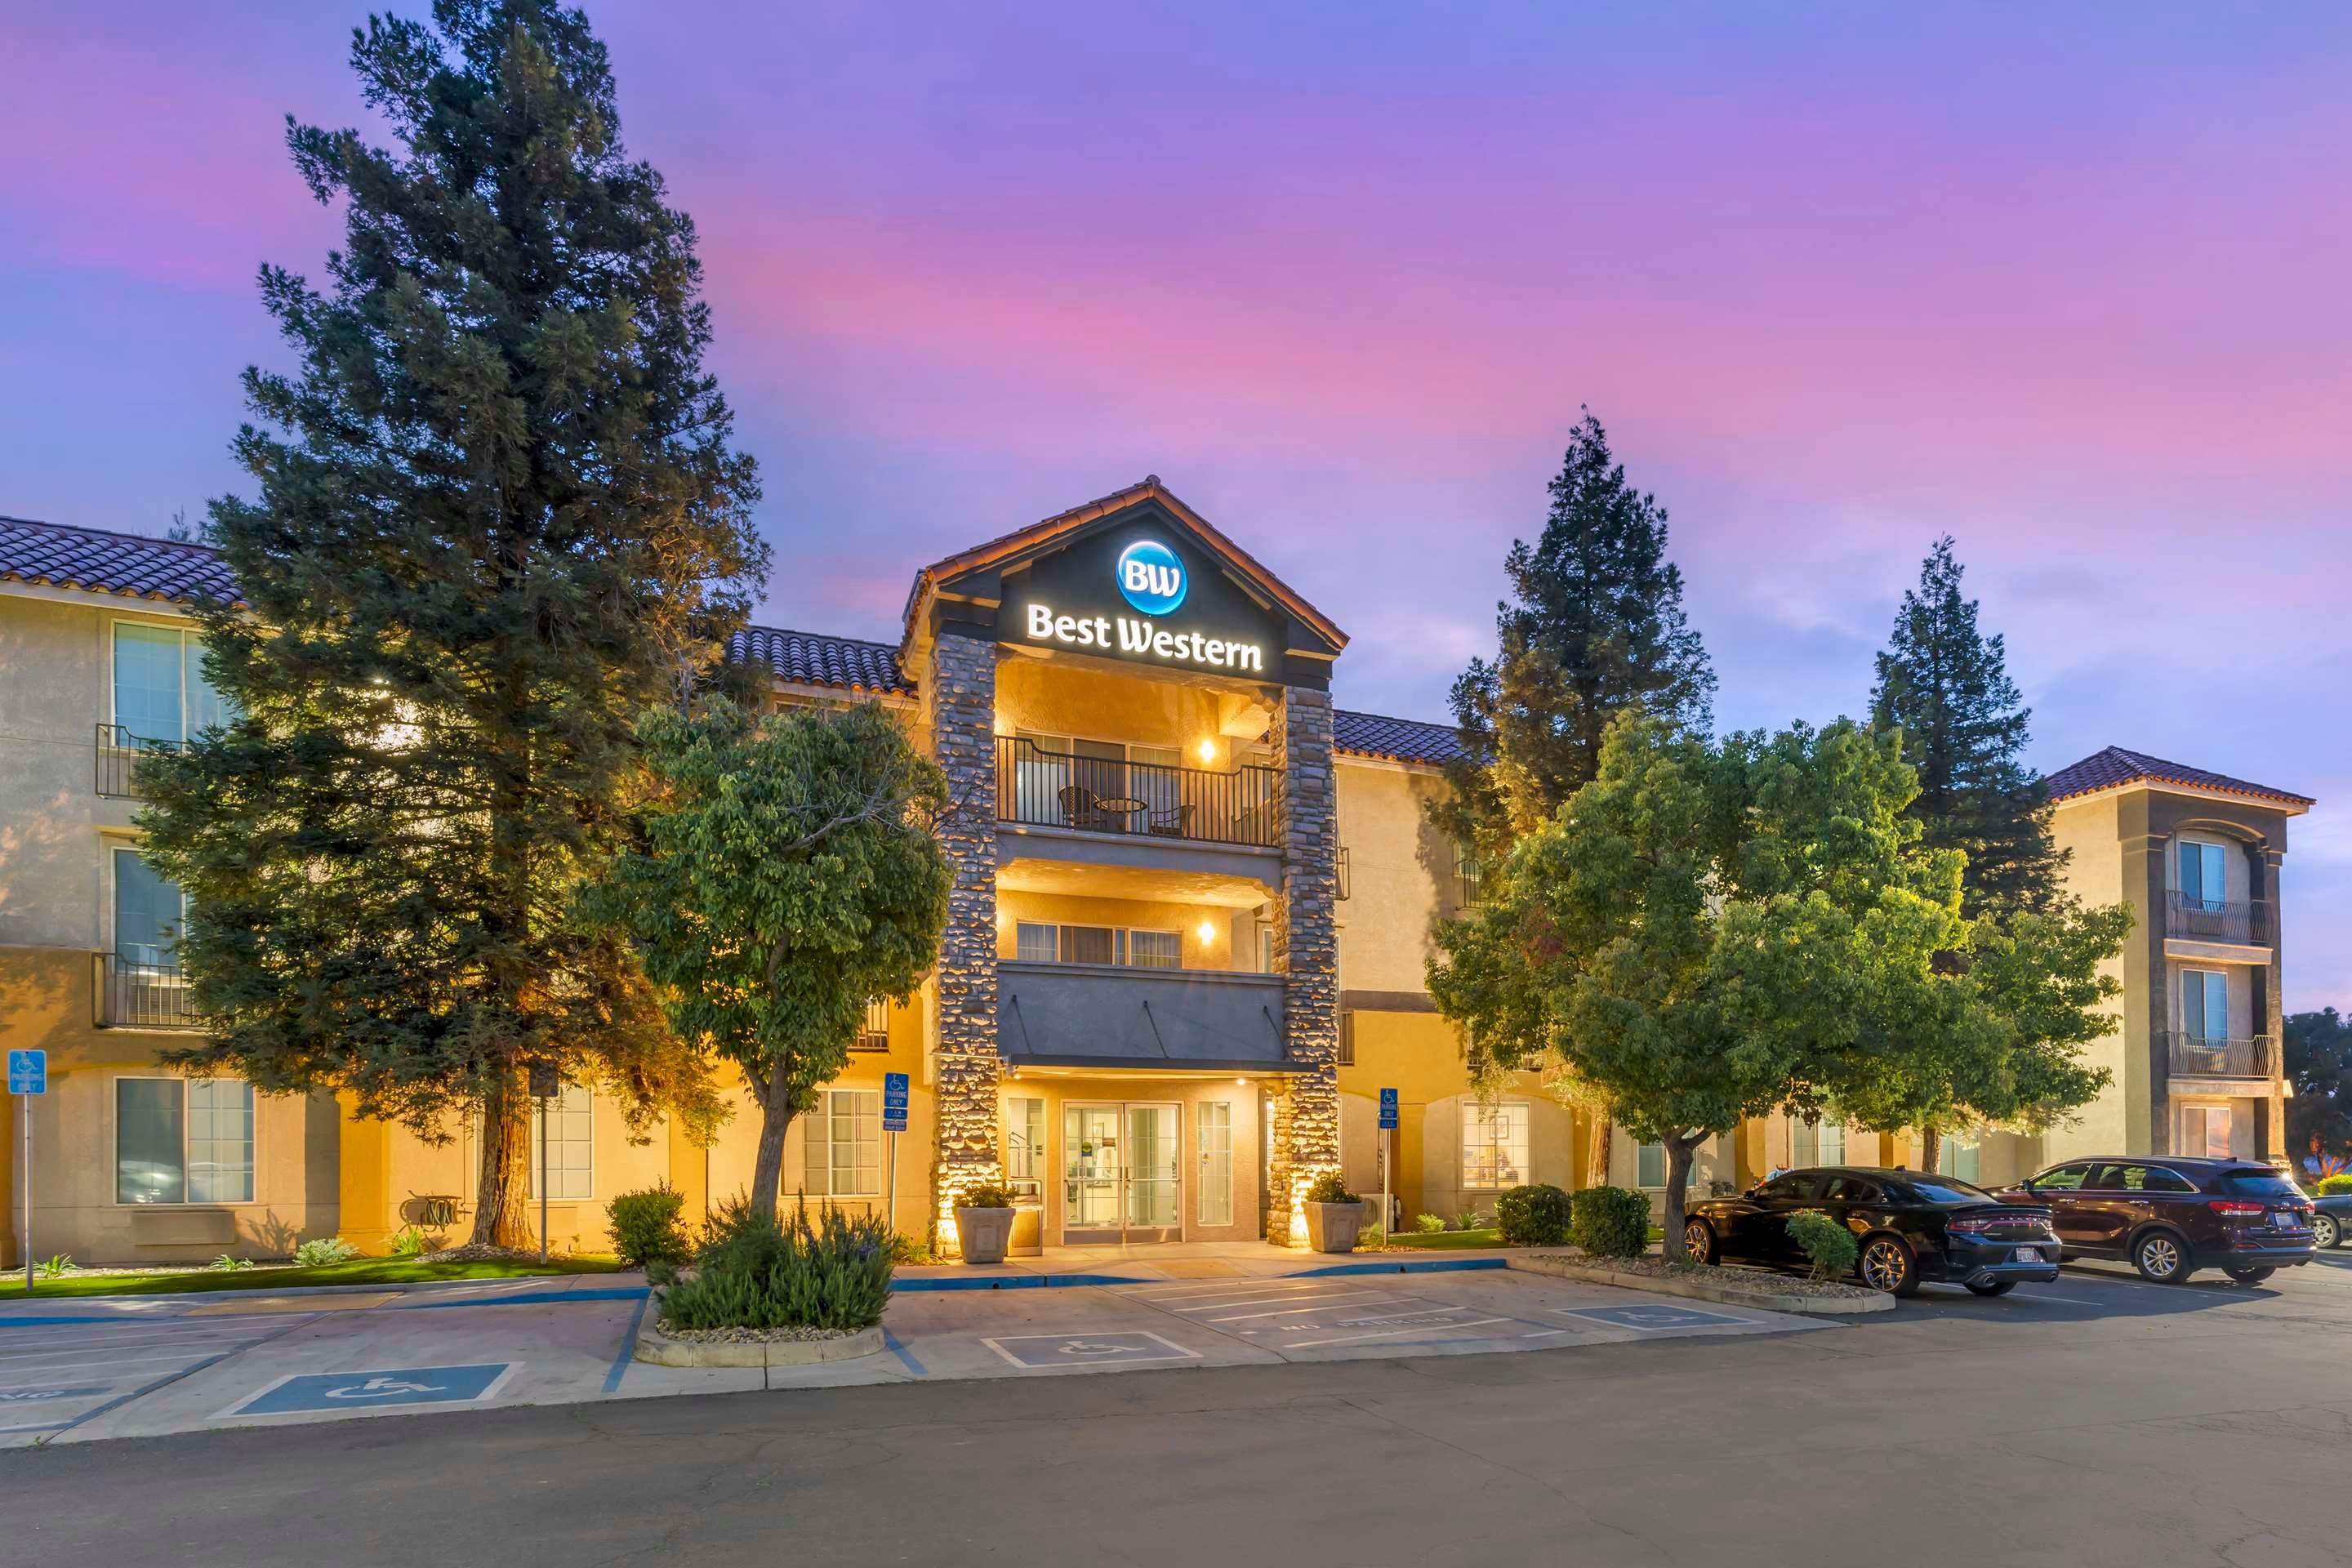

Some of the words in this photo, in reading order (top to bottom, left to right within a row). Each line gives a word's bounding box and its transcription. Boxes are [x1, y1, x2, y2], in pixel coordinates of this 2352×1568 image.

[1125, 560, 1180, 597] BW
[1027, 604, 1111, 648] Best
[1118, 618, 1263, 670] Western
[1335, 1317, 1453, 1327] PARKING
